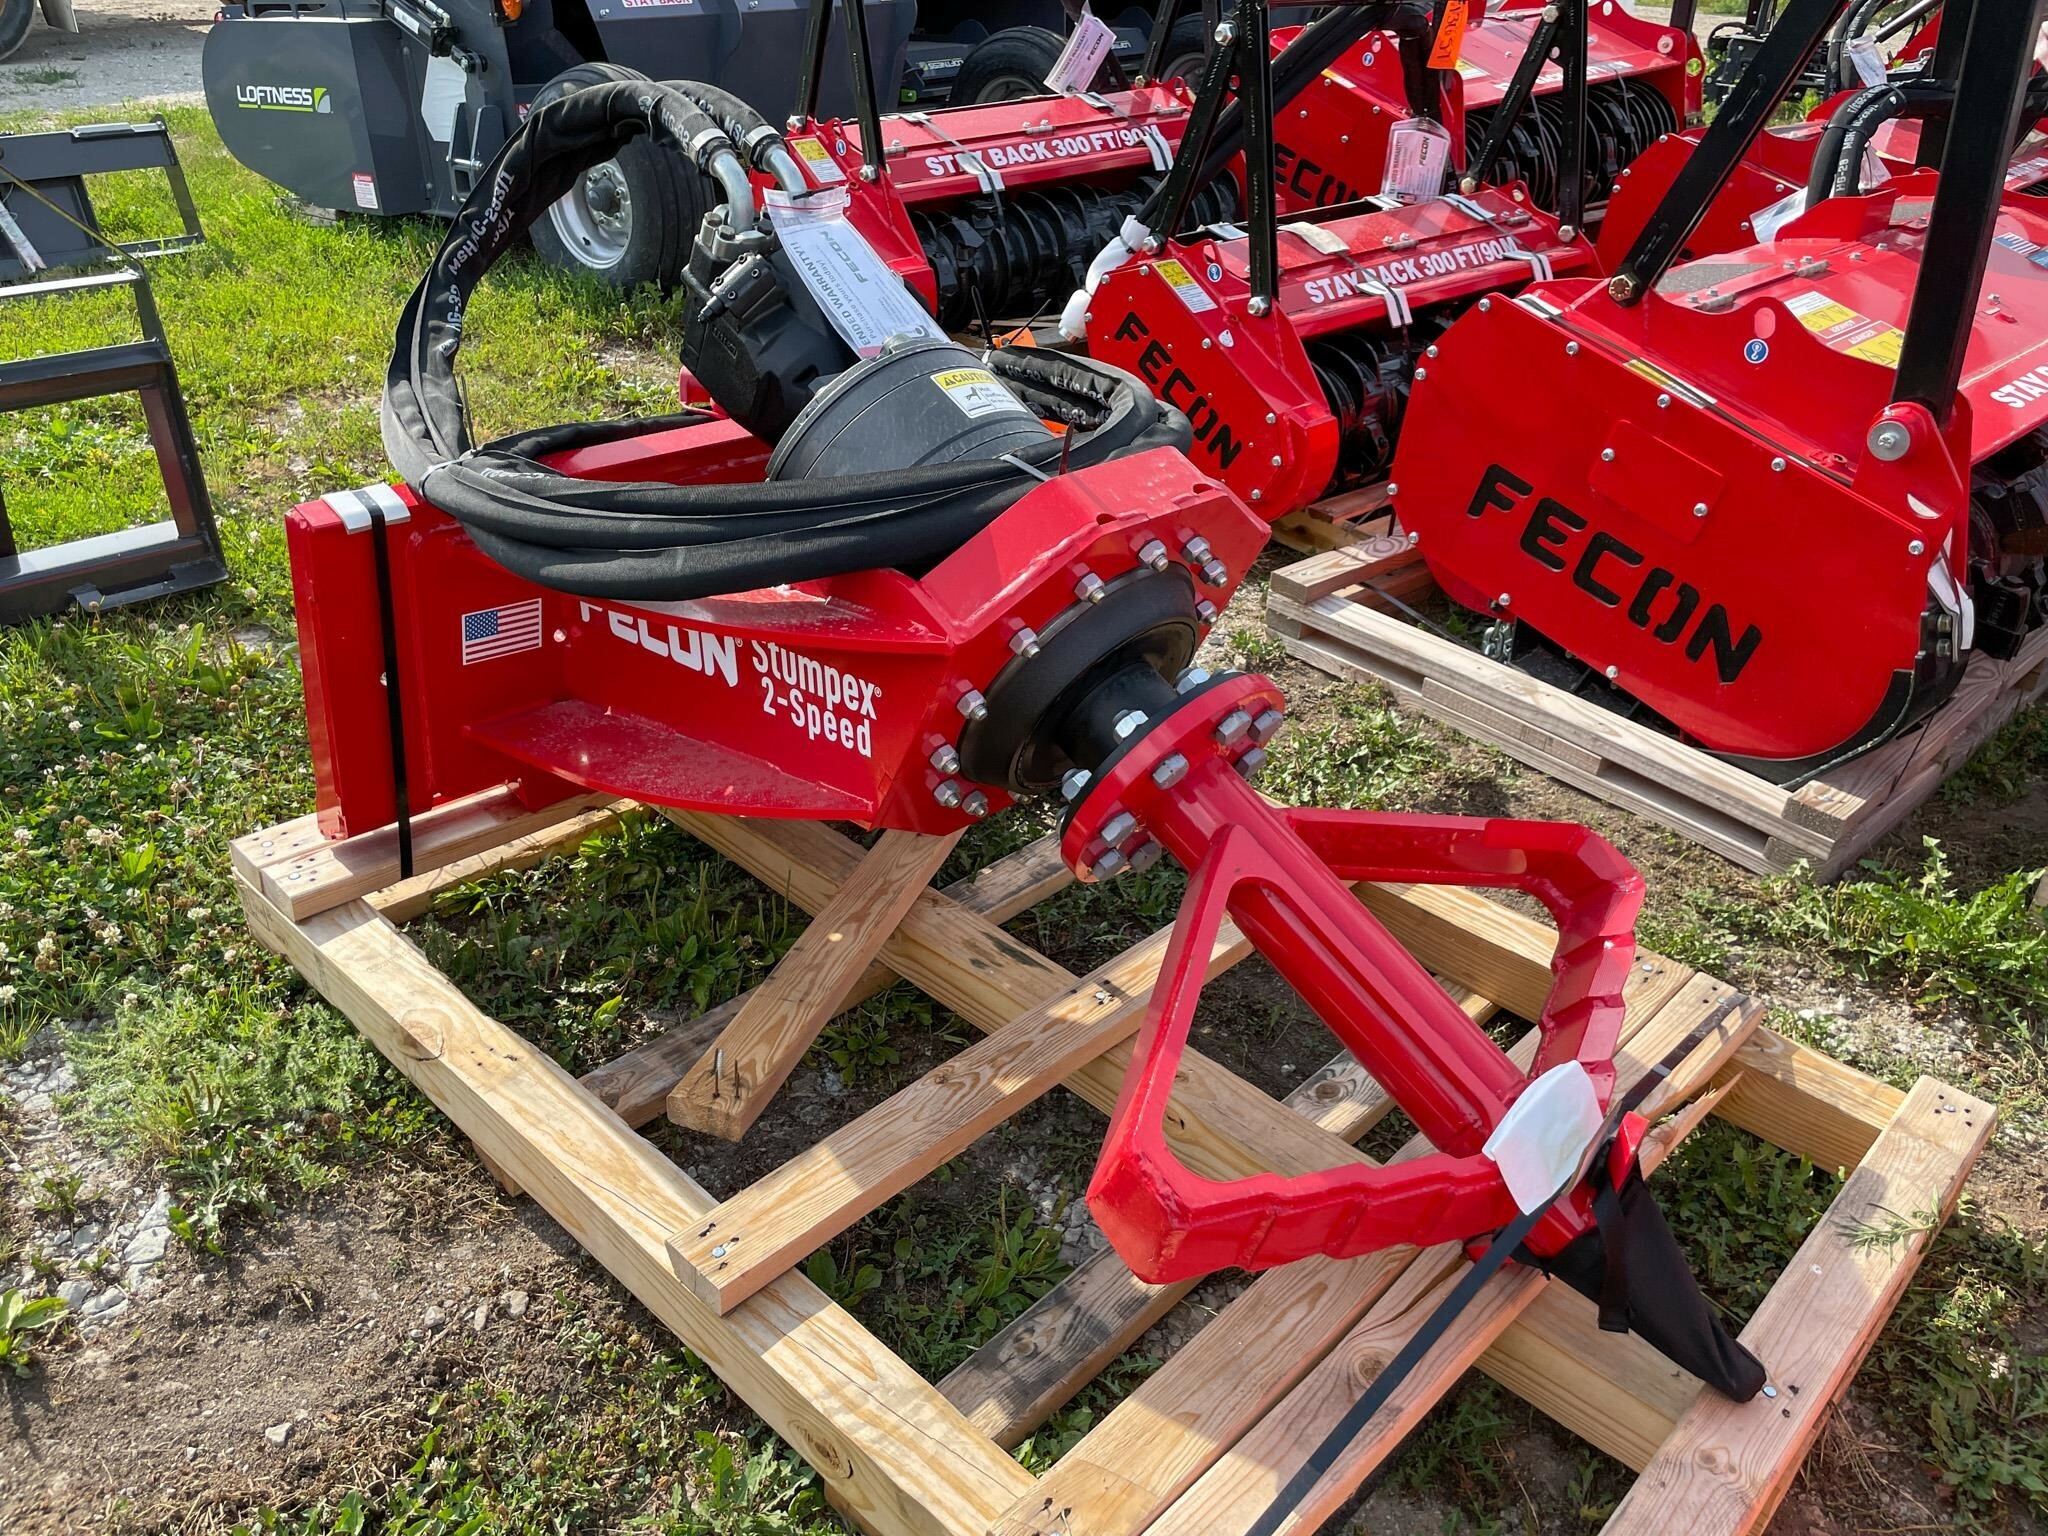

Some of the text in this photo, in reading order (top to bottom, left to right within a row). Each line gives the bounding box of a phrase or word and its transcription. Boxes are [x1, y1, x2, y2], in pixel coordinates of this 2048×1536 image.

[1087, 32, 1104, 61] FECON
[236, 85, 313, 106] LOFTNESS
[988, 141, 1054, 168] BACK
[1051, 135, 1092, 158] 300
[1419, 136, 1430, 167] FECON
[820, 230, 869, 284] FECON
[1304, 271, 1360, 304] STAY
[1418, 252, 1457, 274] 300
[850, 303, 877, 339] Purchase
[1114, 311, 1243, 470] FECON
[1466, 463, 1762, 685] FECON
[763, 676, 873, 759] 2-Speed
